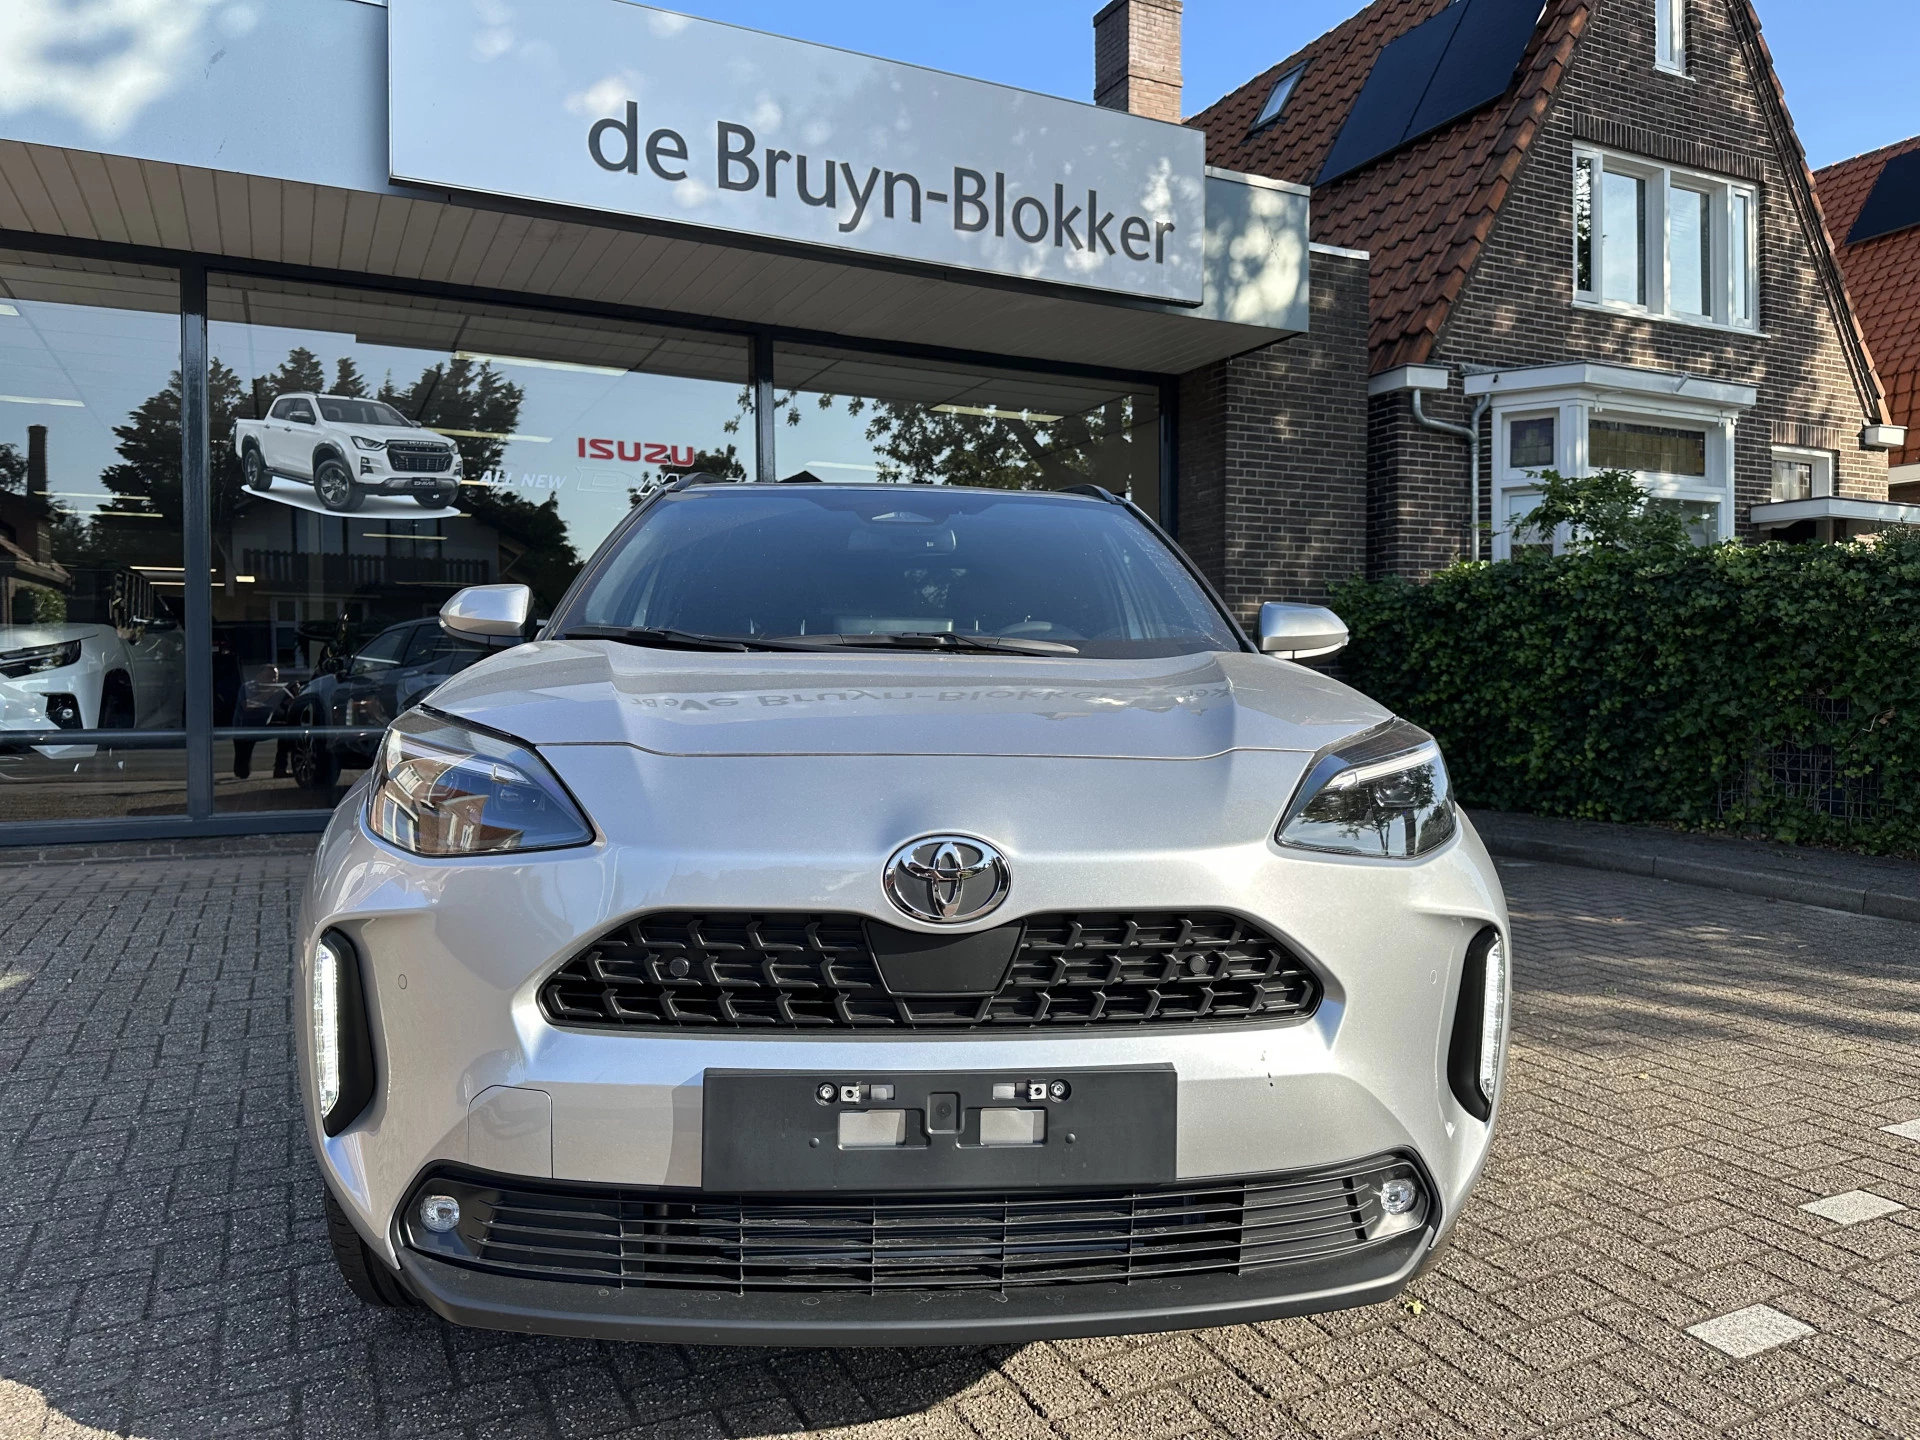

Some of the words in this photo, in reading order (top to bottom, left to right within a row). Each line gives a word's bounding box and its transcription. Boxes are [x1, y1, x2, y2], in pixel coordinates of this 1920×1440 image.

[588, 101, 688, 181] de
[717, 121, 1175, 264] Bruyn-Blokker
[577, 437, 694, 467] ISUZU
[478, 470, 514, 487] ALL
[520, 474, 567, 490] NEW
